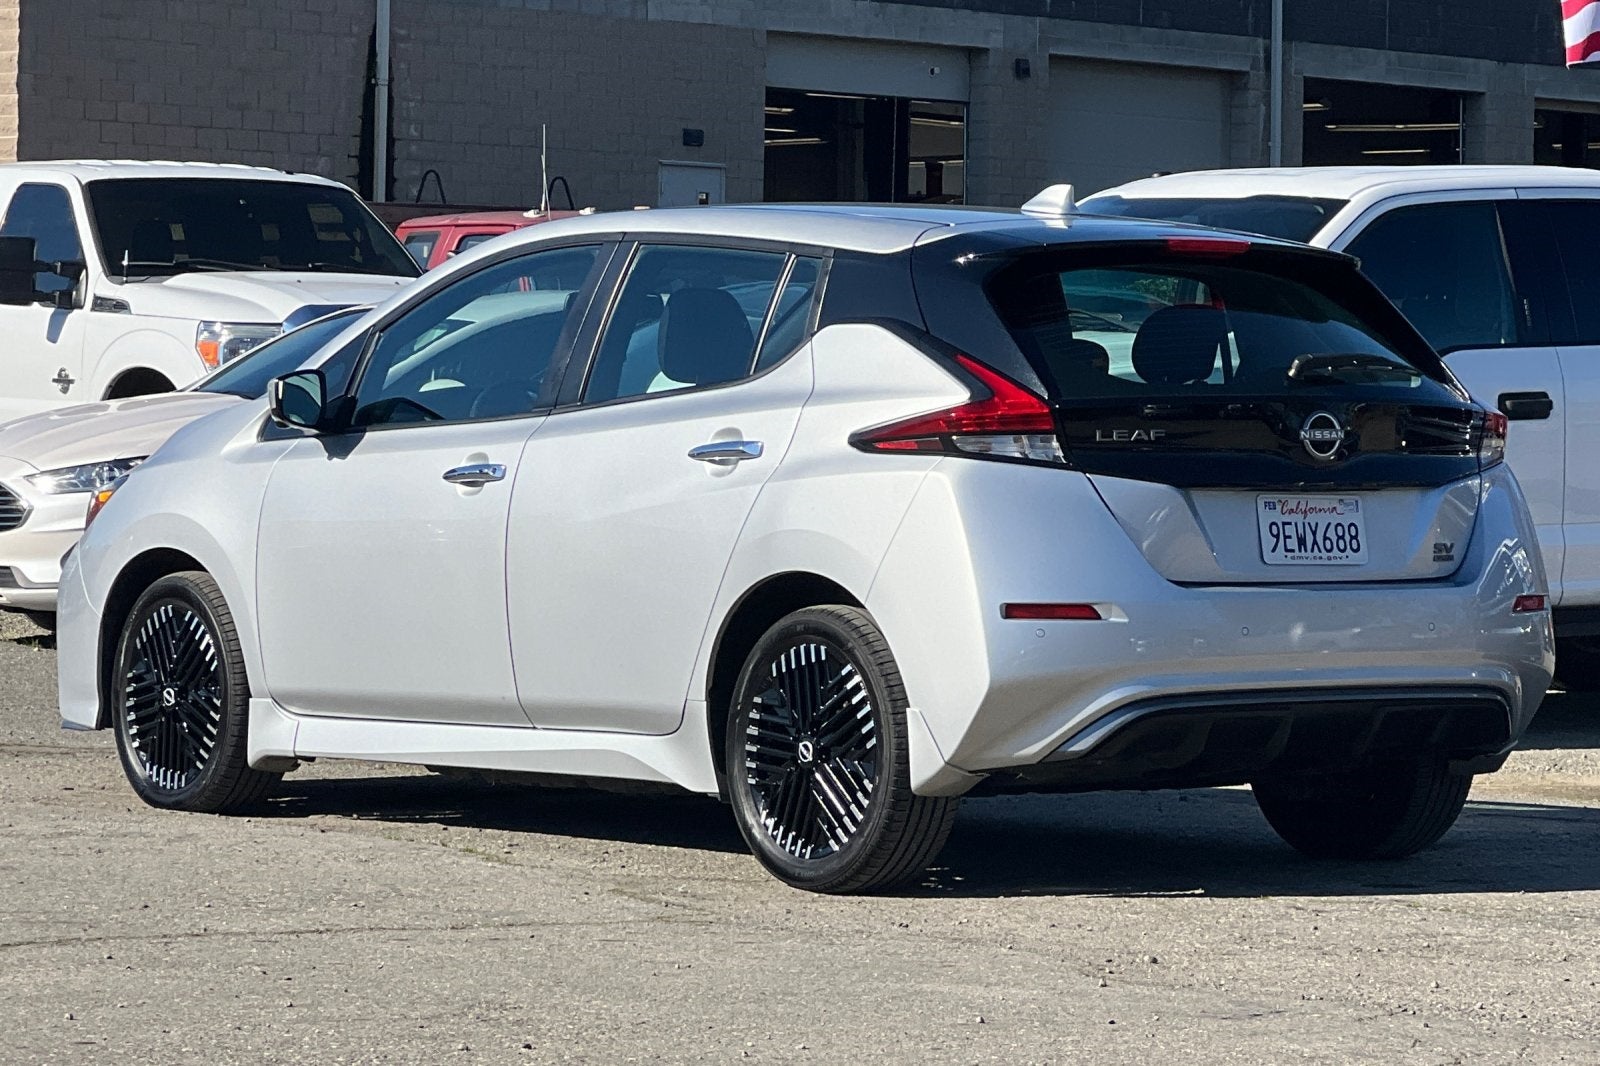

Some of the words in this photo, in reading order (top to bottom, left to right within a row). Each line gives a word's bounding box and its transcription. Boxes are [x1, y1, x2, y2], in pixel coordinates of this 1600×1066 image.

[1095, 429, 1166, 442] LEAF
[1300, 429, 1345, 440] NISSAN
[1264, 501, 1277, 510] FEB
[1281, 499, 1344, 520] California
[1268, 521, 1361, 554] 9EWX688
[1433, 542, 1455, 554] SV
